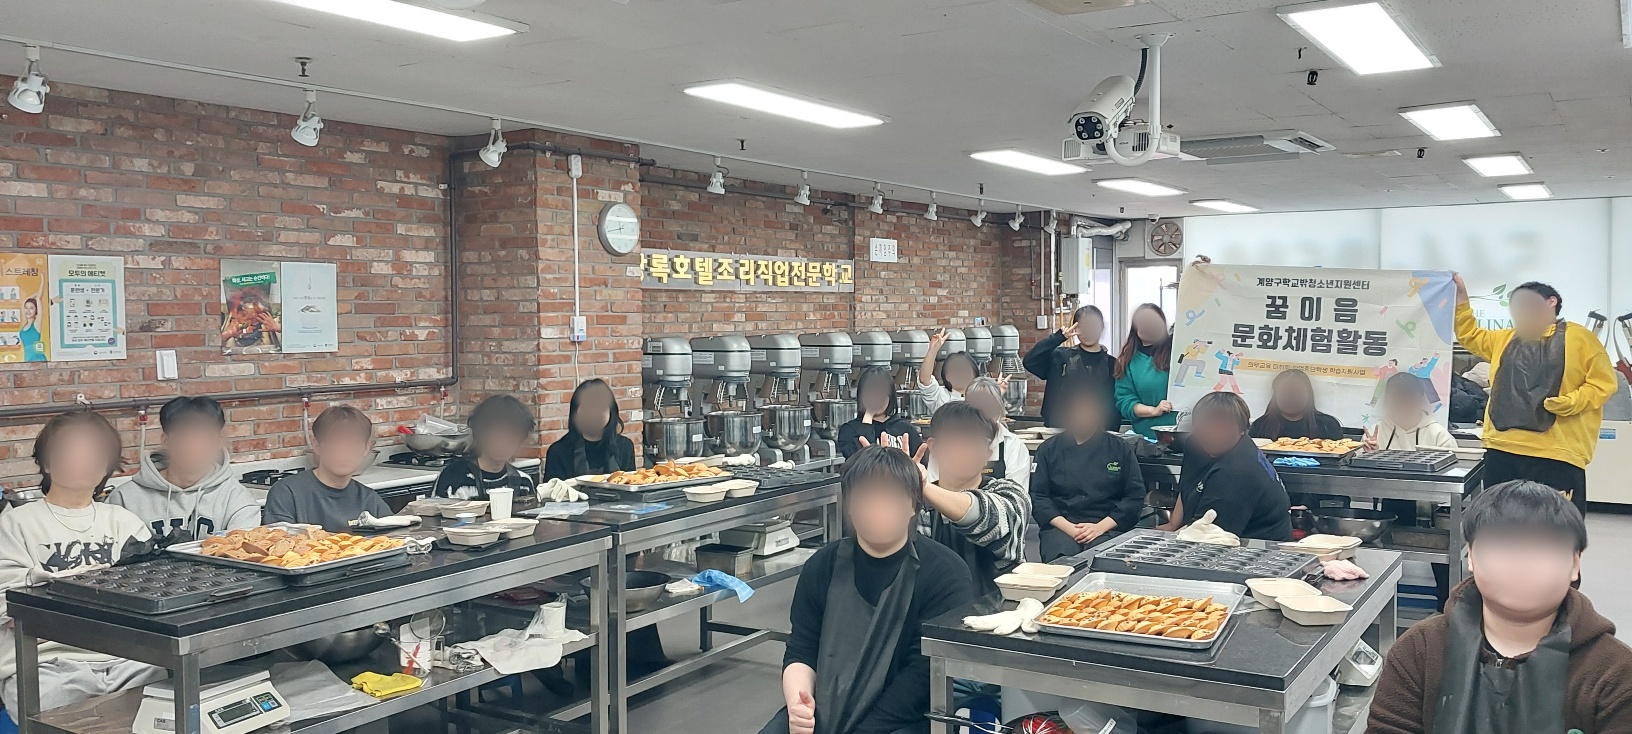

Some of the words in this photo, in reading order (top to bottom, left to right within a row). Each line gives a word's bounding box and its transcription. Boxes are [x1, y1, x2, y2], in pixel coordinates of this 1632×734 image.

[5, 267, 38, 276] 스트레칭
[1256, 277, 1370, 290] 계양구학교밖청소년지원센터
[1231, 323, 1389, 357] 문화체험활동
